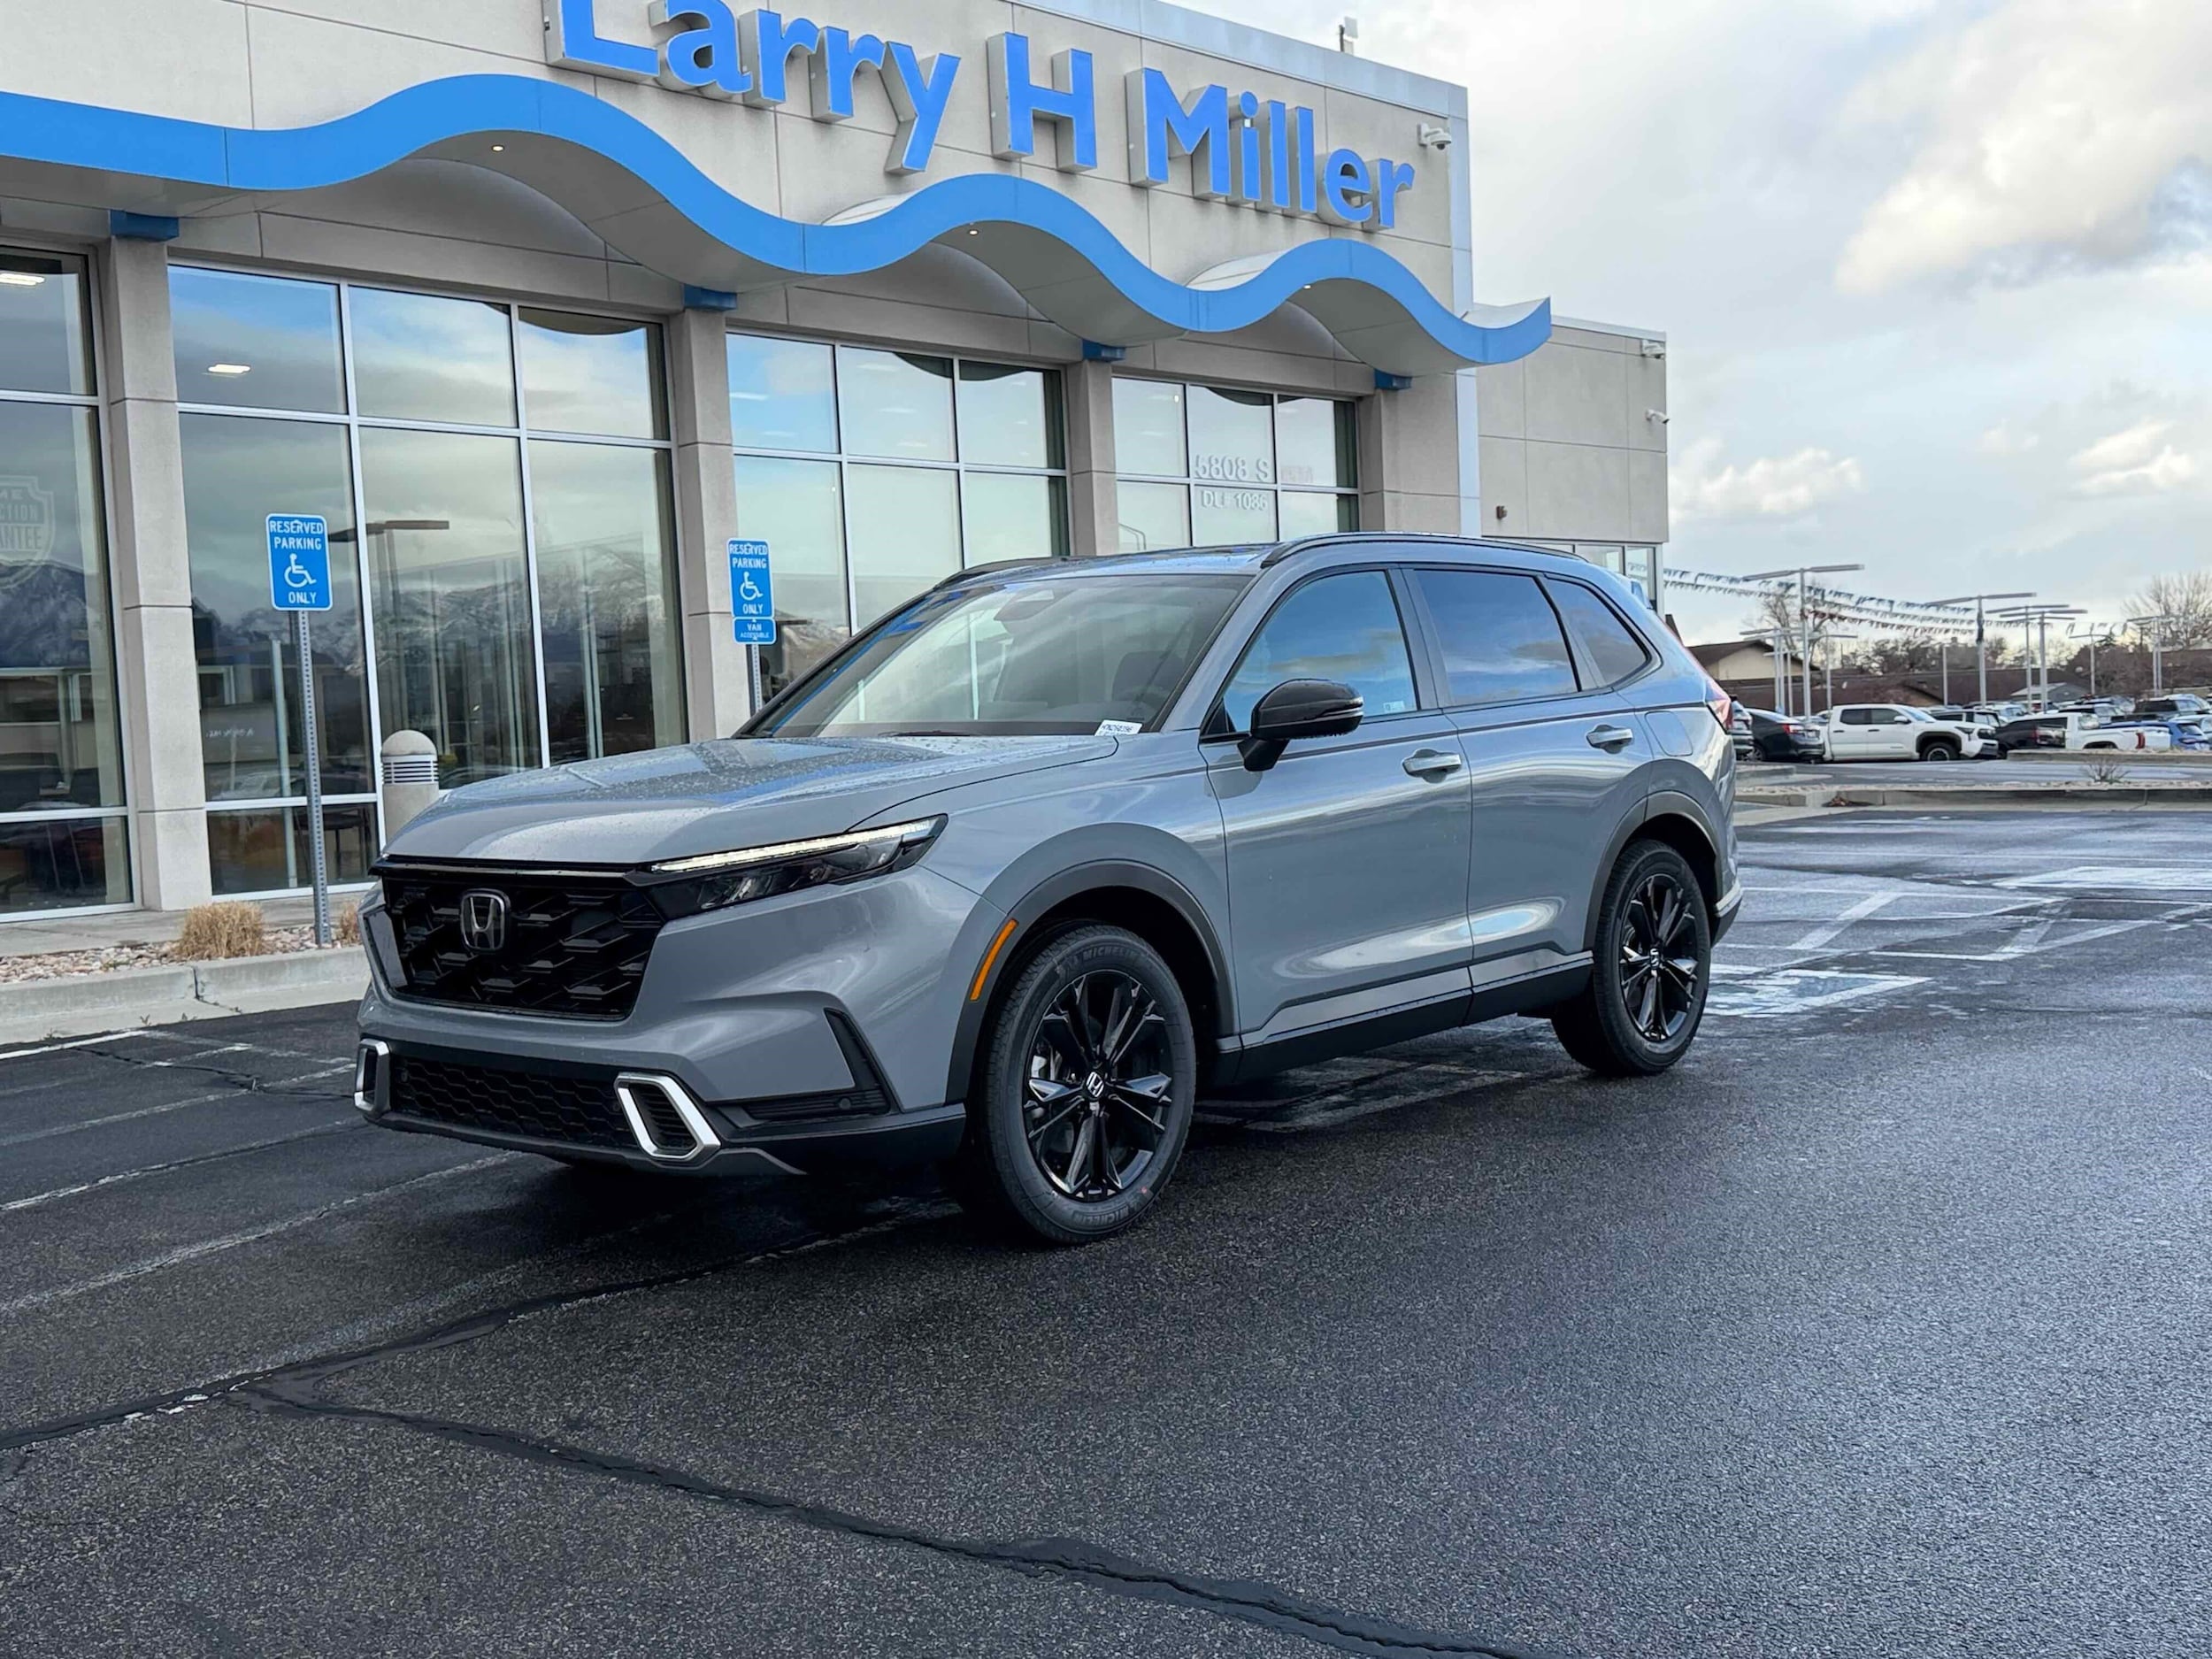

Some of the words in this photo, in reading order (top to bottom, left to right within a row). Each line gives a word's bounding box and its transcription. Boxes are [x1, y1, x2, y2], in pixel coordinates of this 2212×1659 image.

[557, 0, 962, 173] Larry
[1000, 32, 1098, 170] H
[1140, 67, 1416, 229] Miller
[1256, 457, 1271, 483] S
[1233, 492, 1268, 511] 1086
[269, 520, 324, 534] RESERVED
[273, 536, 322, 550] PARKING
[728, 543, 768, 556] RESERVED
[732, 557, 767, 569] PARKING
[288, 591, 317, 604] ONLY
[742, 603, 764, 615] ONLY
[747, 623, 762, 632] VAN
